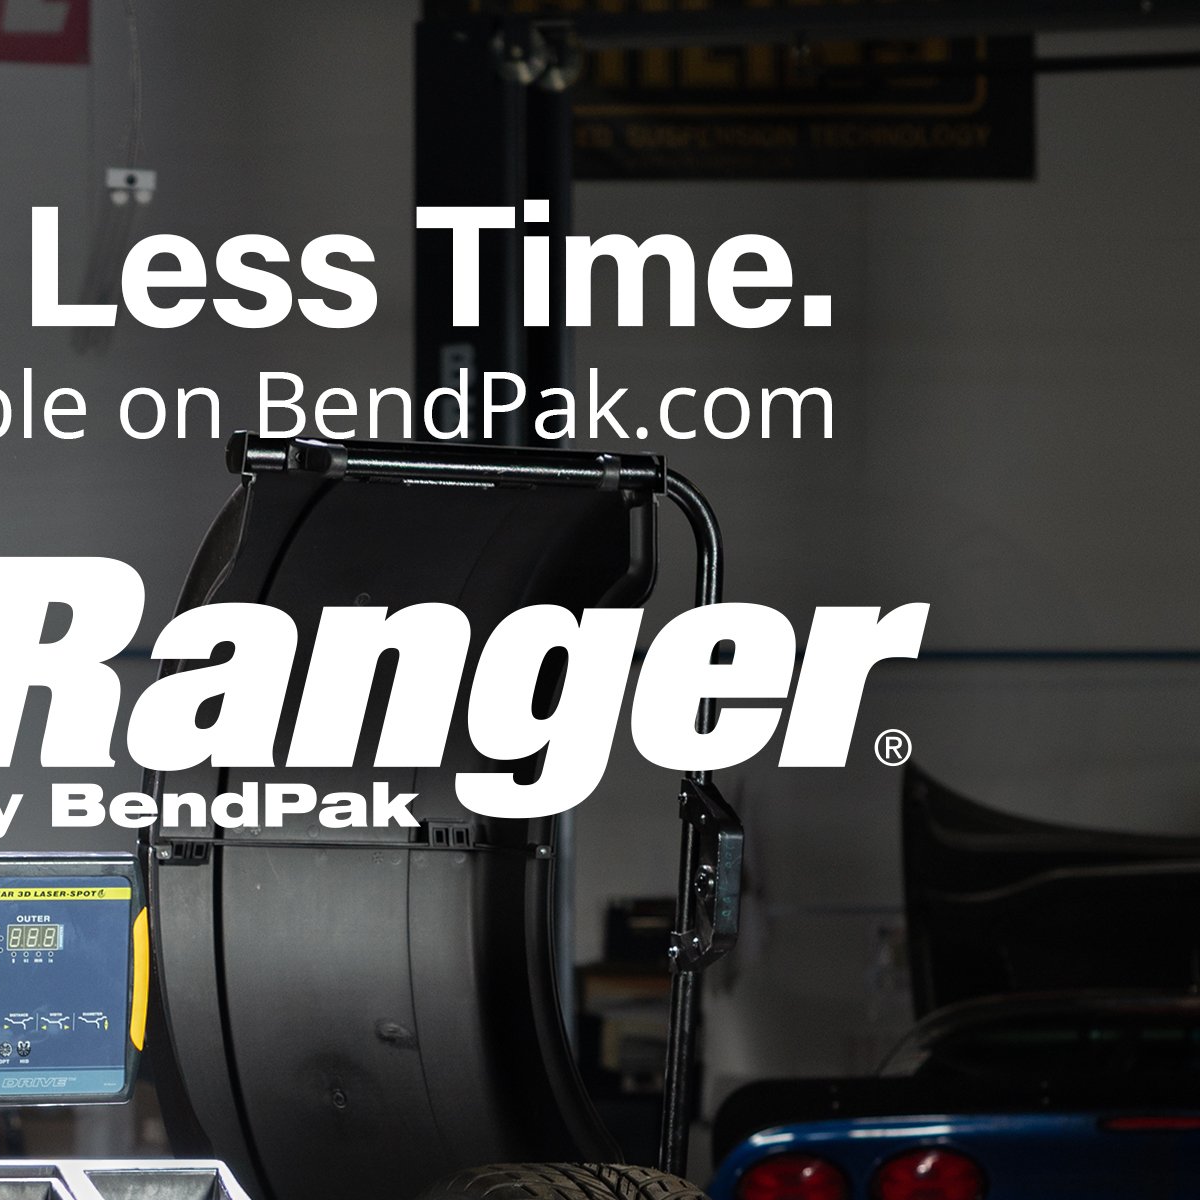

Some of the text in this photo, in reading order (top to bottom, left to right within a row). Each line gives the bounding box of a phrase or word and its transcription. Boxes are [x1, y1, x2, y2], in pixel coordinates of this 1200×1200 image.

[809, 125, 991, 148] TECHNOLOGY
[17, 890, 31, 898] 3D
[33, 889, 97, 898] LASER-SPOT
[16, 915, 51, 923] OUTER
